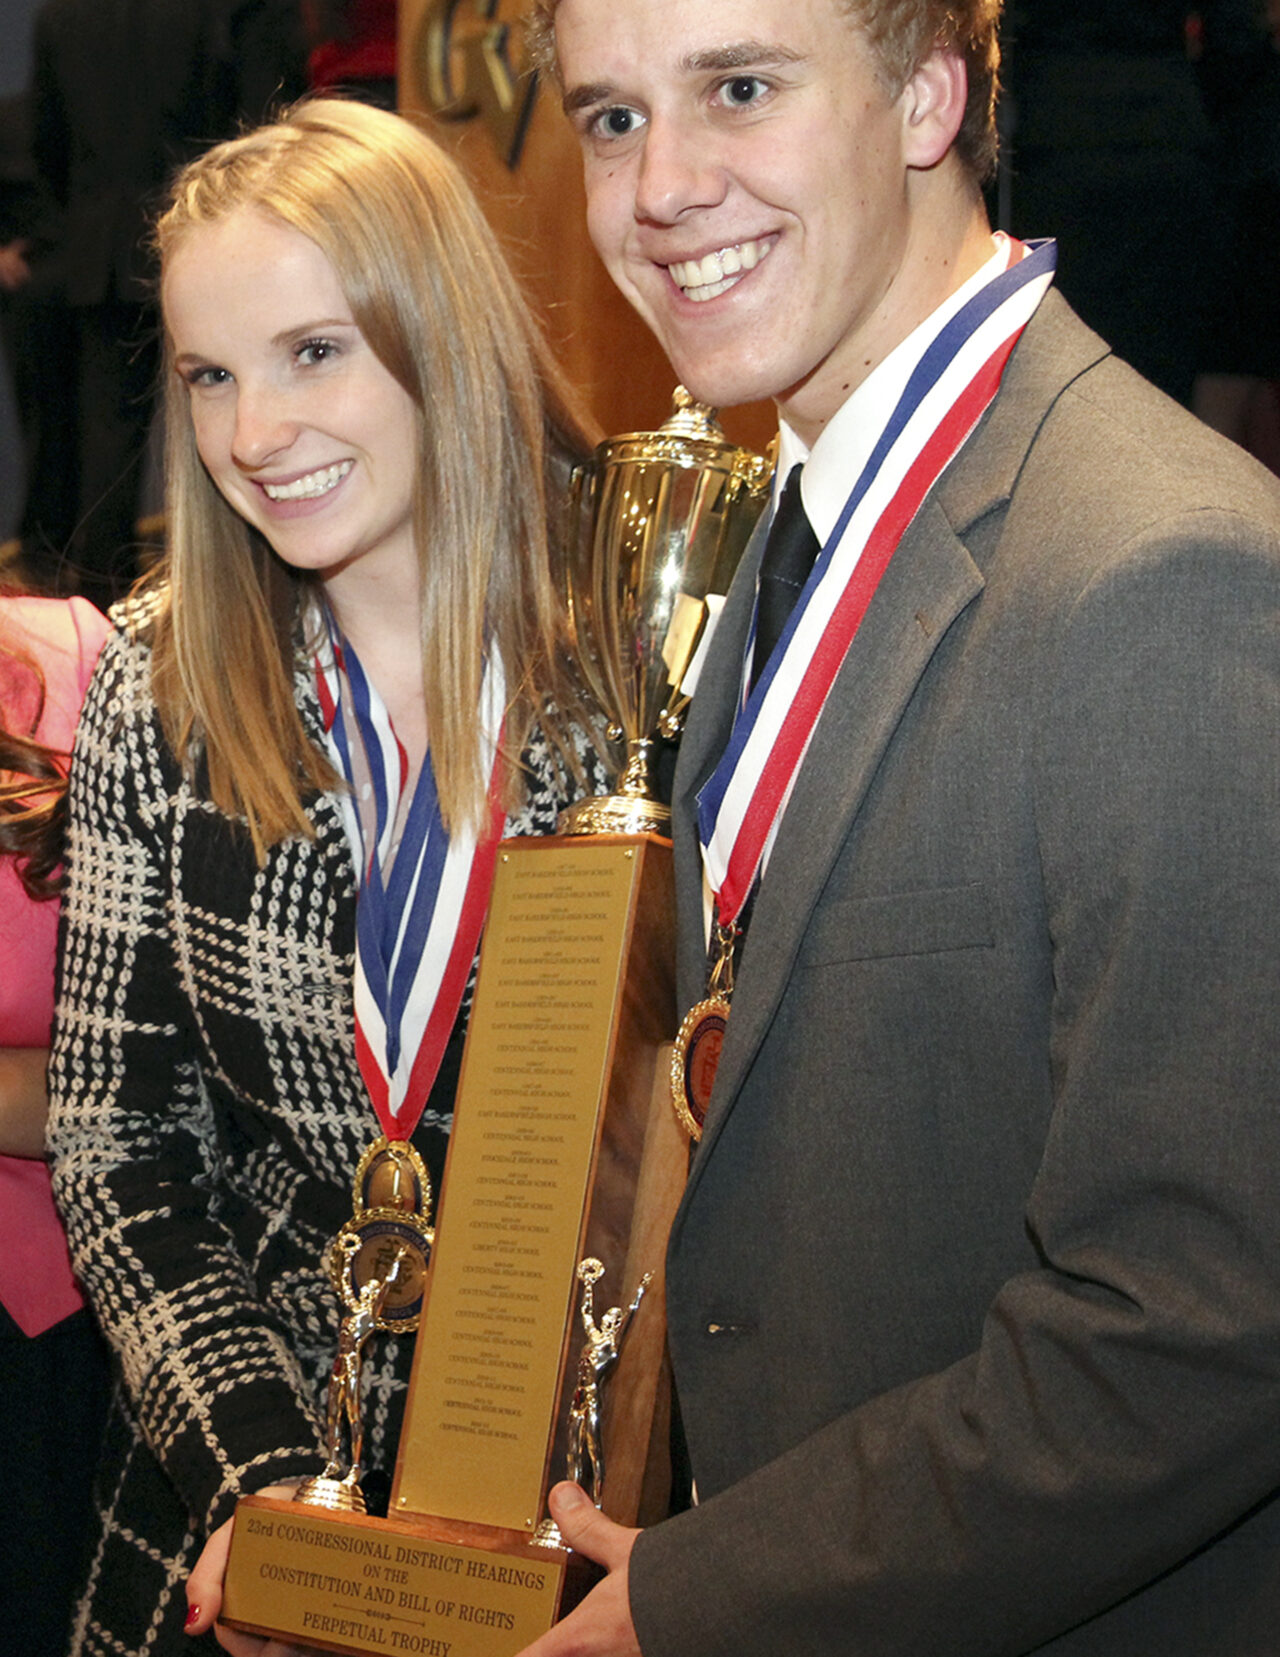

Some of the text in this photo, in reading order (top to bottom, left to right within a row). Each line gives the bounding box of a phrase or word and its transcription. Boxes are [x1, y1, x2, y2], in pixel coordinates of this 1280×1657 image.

[247, 1518, 545, 1591] 23rd CONGRESSIONAL DISTRICT HEARINGS
[363, 1563, 409, 1585] ON THE
[259, 1562, 515, 1631] CONSTITUTION AND BILL OF RIGHTS
[302, 1611, 452, 1657] PERPETUAL TROPHY
